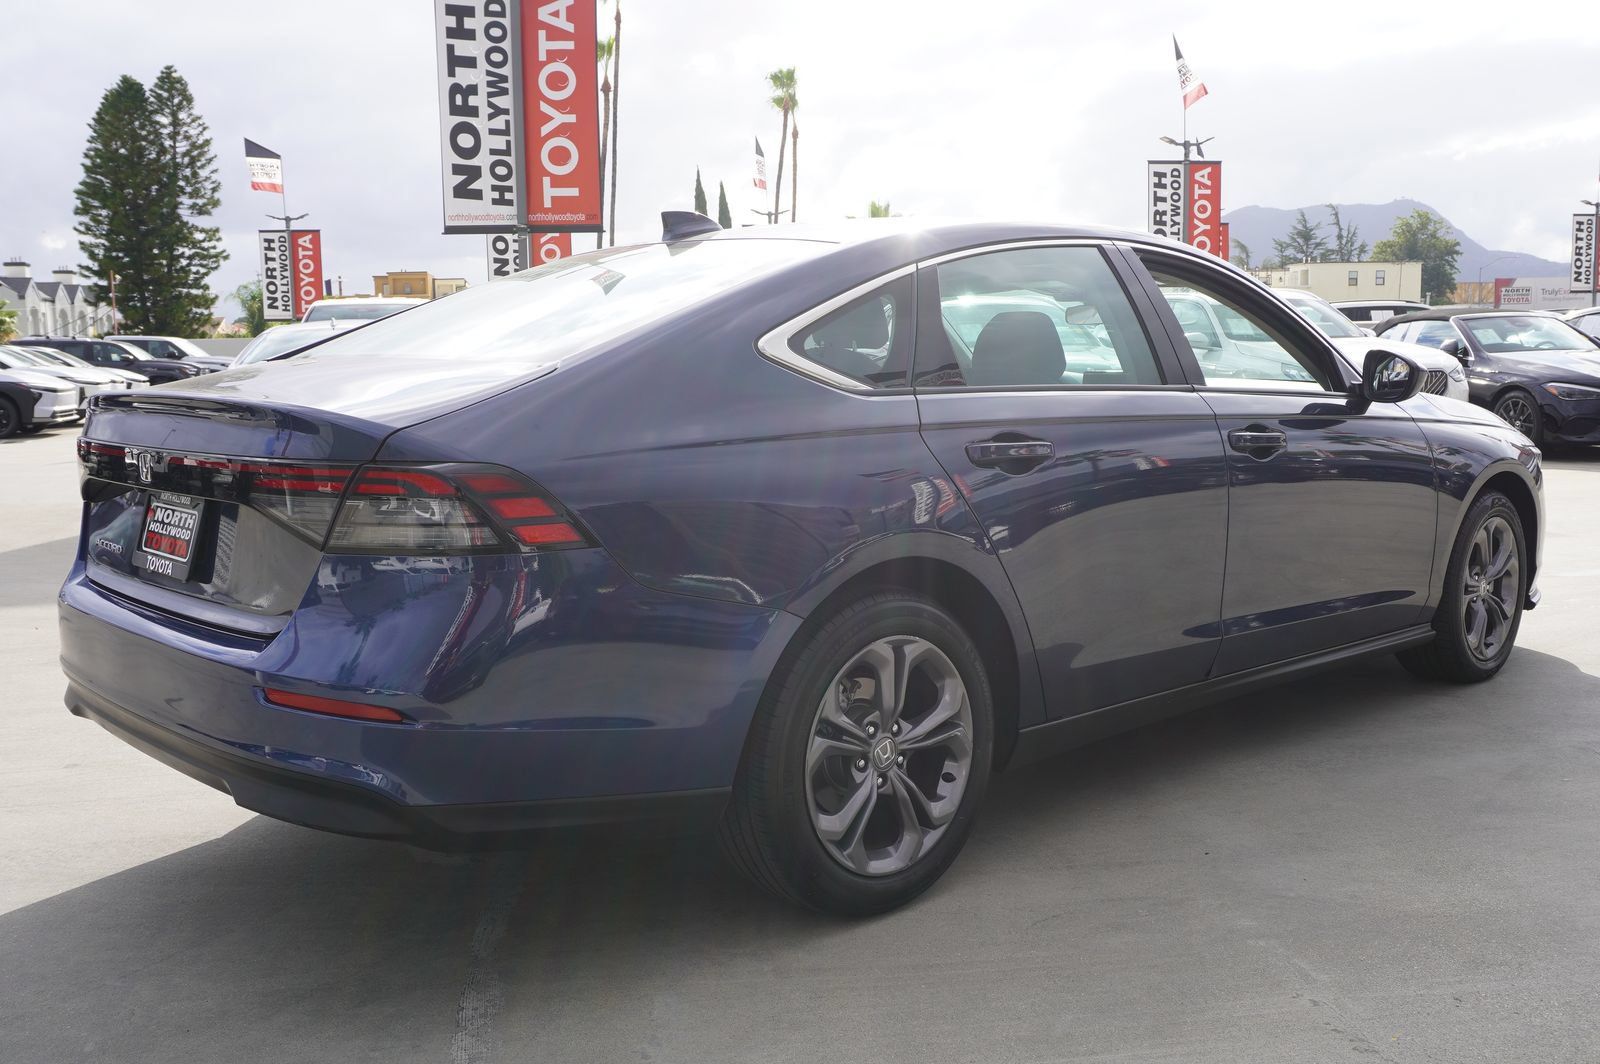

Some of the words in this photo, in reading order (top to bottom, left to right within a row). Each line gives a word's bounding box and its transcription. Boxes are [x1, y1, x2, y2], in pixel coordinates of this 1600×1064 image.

[445, 3, 484, 201] NORTH
[483, 0, 514, 207] HOLLYWOOD
[537, 0, 580, 208] TOYOTA
[1153, 171, 1168, 238] RTH
[1192, 167, 1212, 252] OYOTA
[263, 237, 279, 310] NORTH
[278, 235, 291, 312] HOLLYWOOD
[297, 233, 316, 313] TOYOTA
[1573, 220, 1585, 283] NORTH
[1584, 218, 1594, 285] HOLLYWOOD
[146, 531, 187, 558] TOYOTA
[148, 521, 191, 540] HOLLYWOOD
[154, 508, 196, 529] NORTH
[146, 555, 173, 576] TOYOTA
